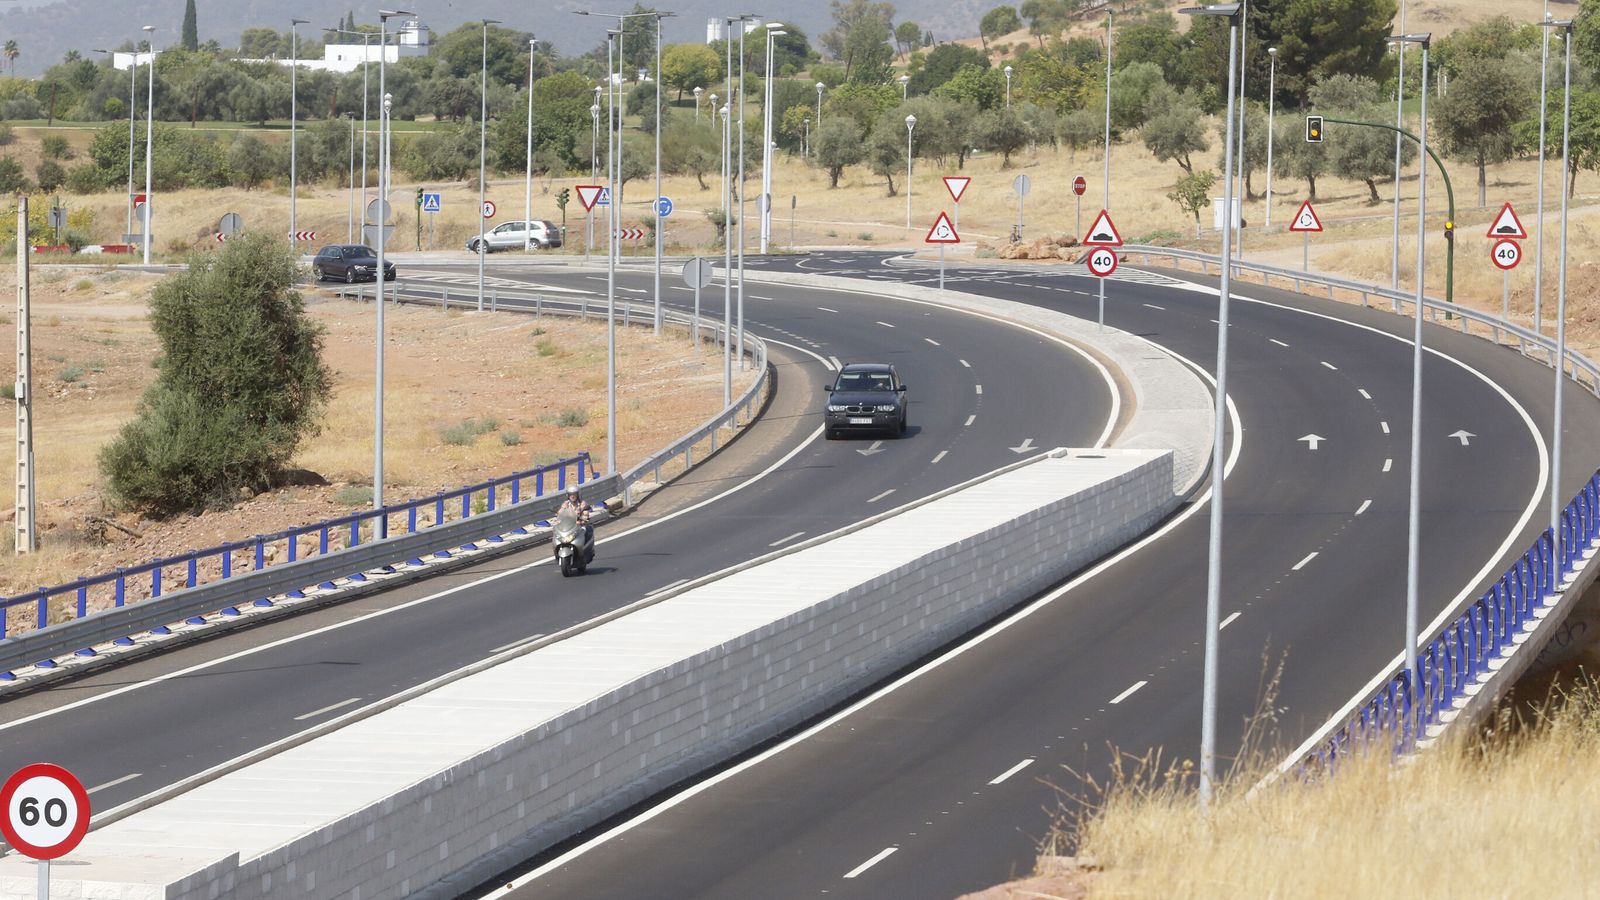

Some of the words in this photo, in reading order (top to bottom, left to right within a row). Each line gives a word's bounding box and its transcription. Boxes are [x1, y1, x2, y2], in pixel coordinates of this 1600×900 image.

[1498, 249, 1515, 259] 40
[1094, 256, 1111, 266] 40
[19, 796, 68, 828] 60
